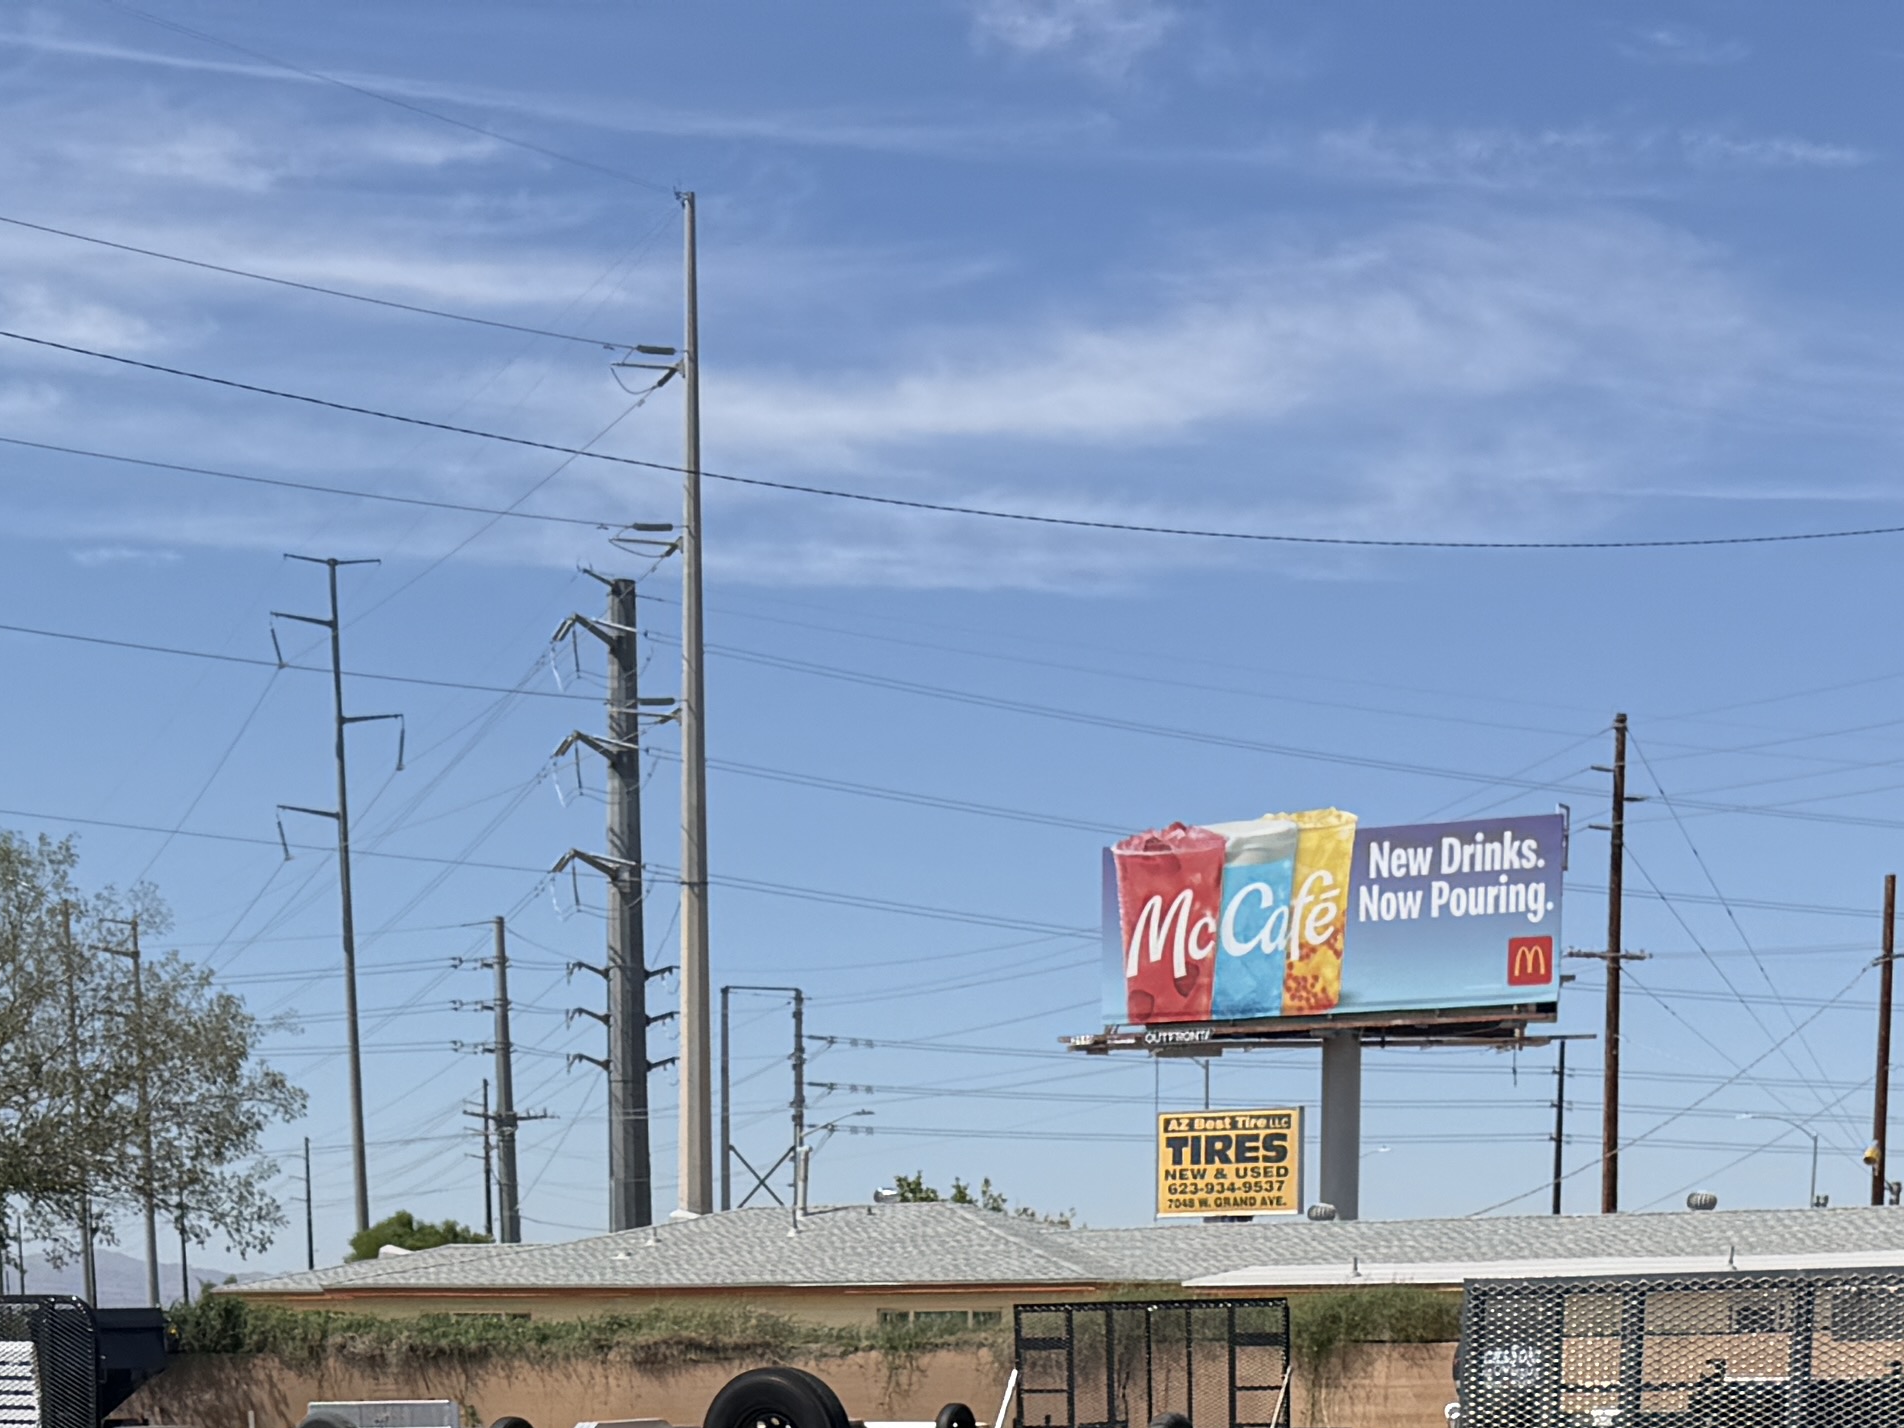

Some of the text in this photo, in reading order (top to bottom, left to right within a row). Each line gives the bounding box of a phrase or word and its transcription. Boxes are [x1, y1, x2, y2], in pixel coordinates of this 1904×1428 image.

[1369, 830, 1545, 879] New Drinks.
[1359, 874, 1554, 923] Now Pouring.
[1126, 869, 1341, 979] McCafé
[1168, 1118, 1190, 1131] AZ
[1235, 1116, 1268, 1129] Tire
[1269, 1116, 1289, 1128] LLC
[1166, 1133, 1289, 1166] TIRES
[1164, 1166, 1290, 1181] NEW & USED
[1168, 1180, 1285, 1195] 623-934-9537
[1214, 1196, 1257, 1208] GRAND
[1260, 1195, 1287, 1207] AVE.
